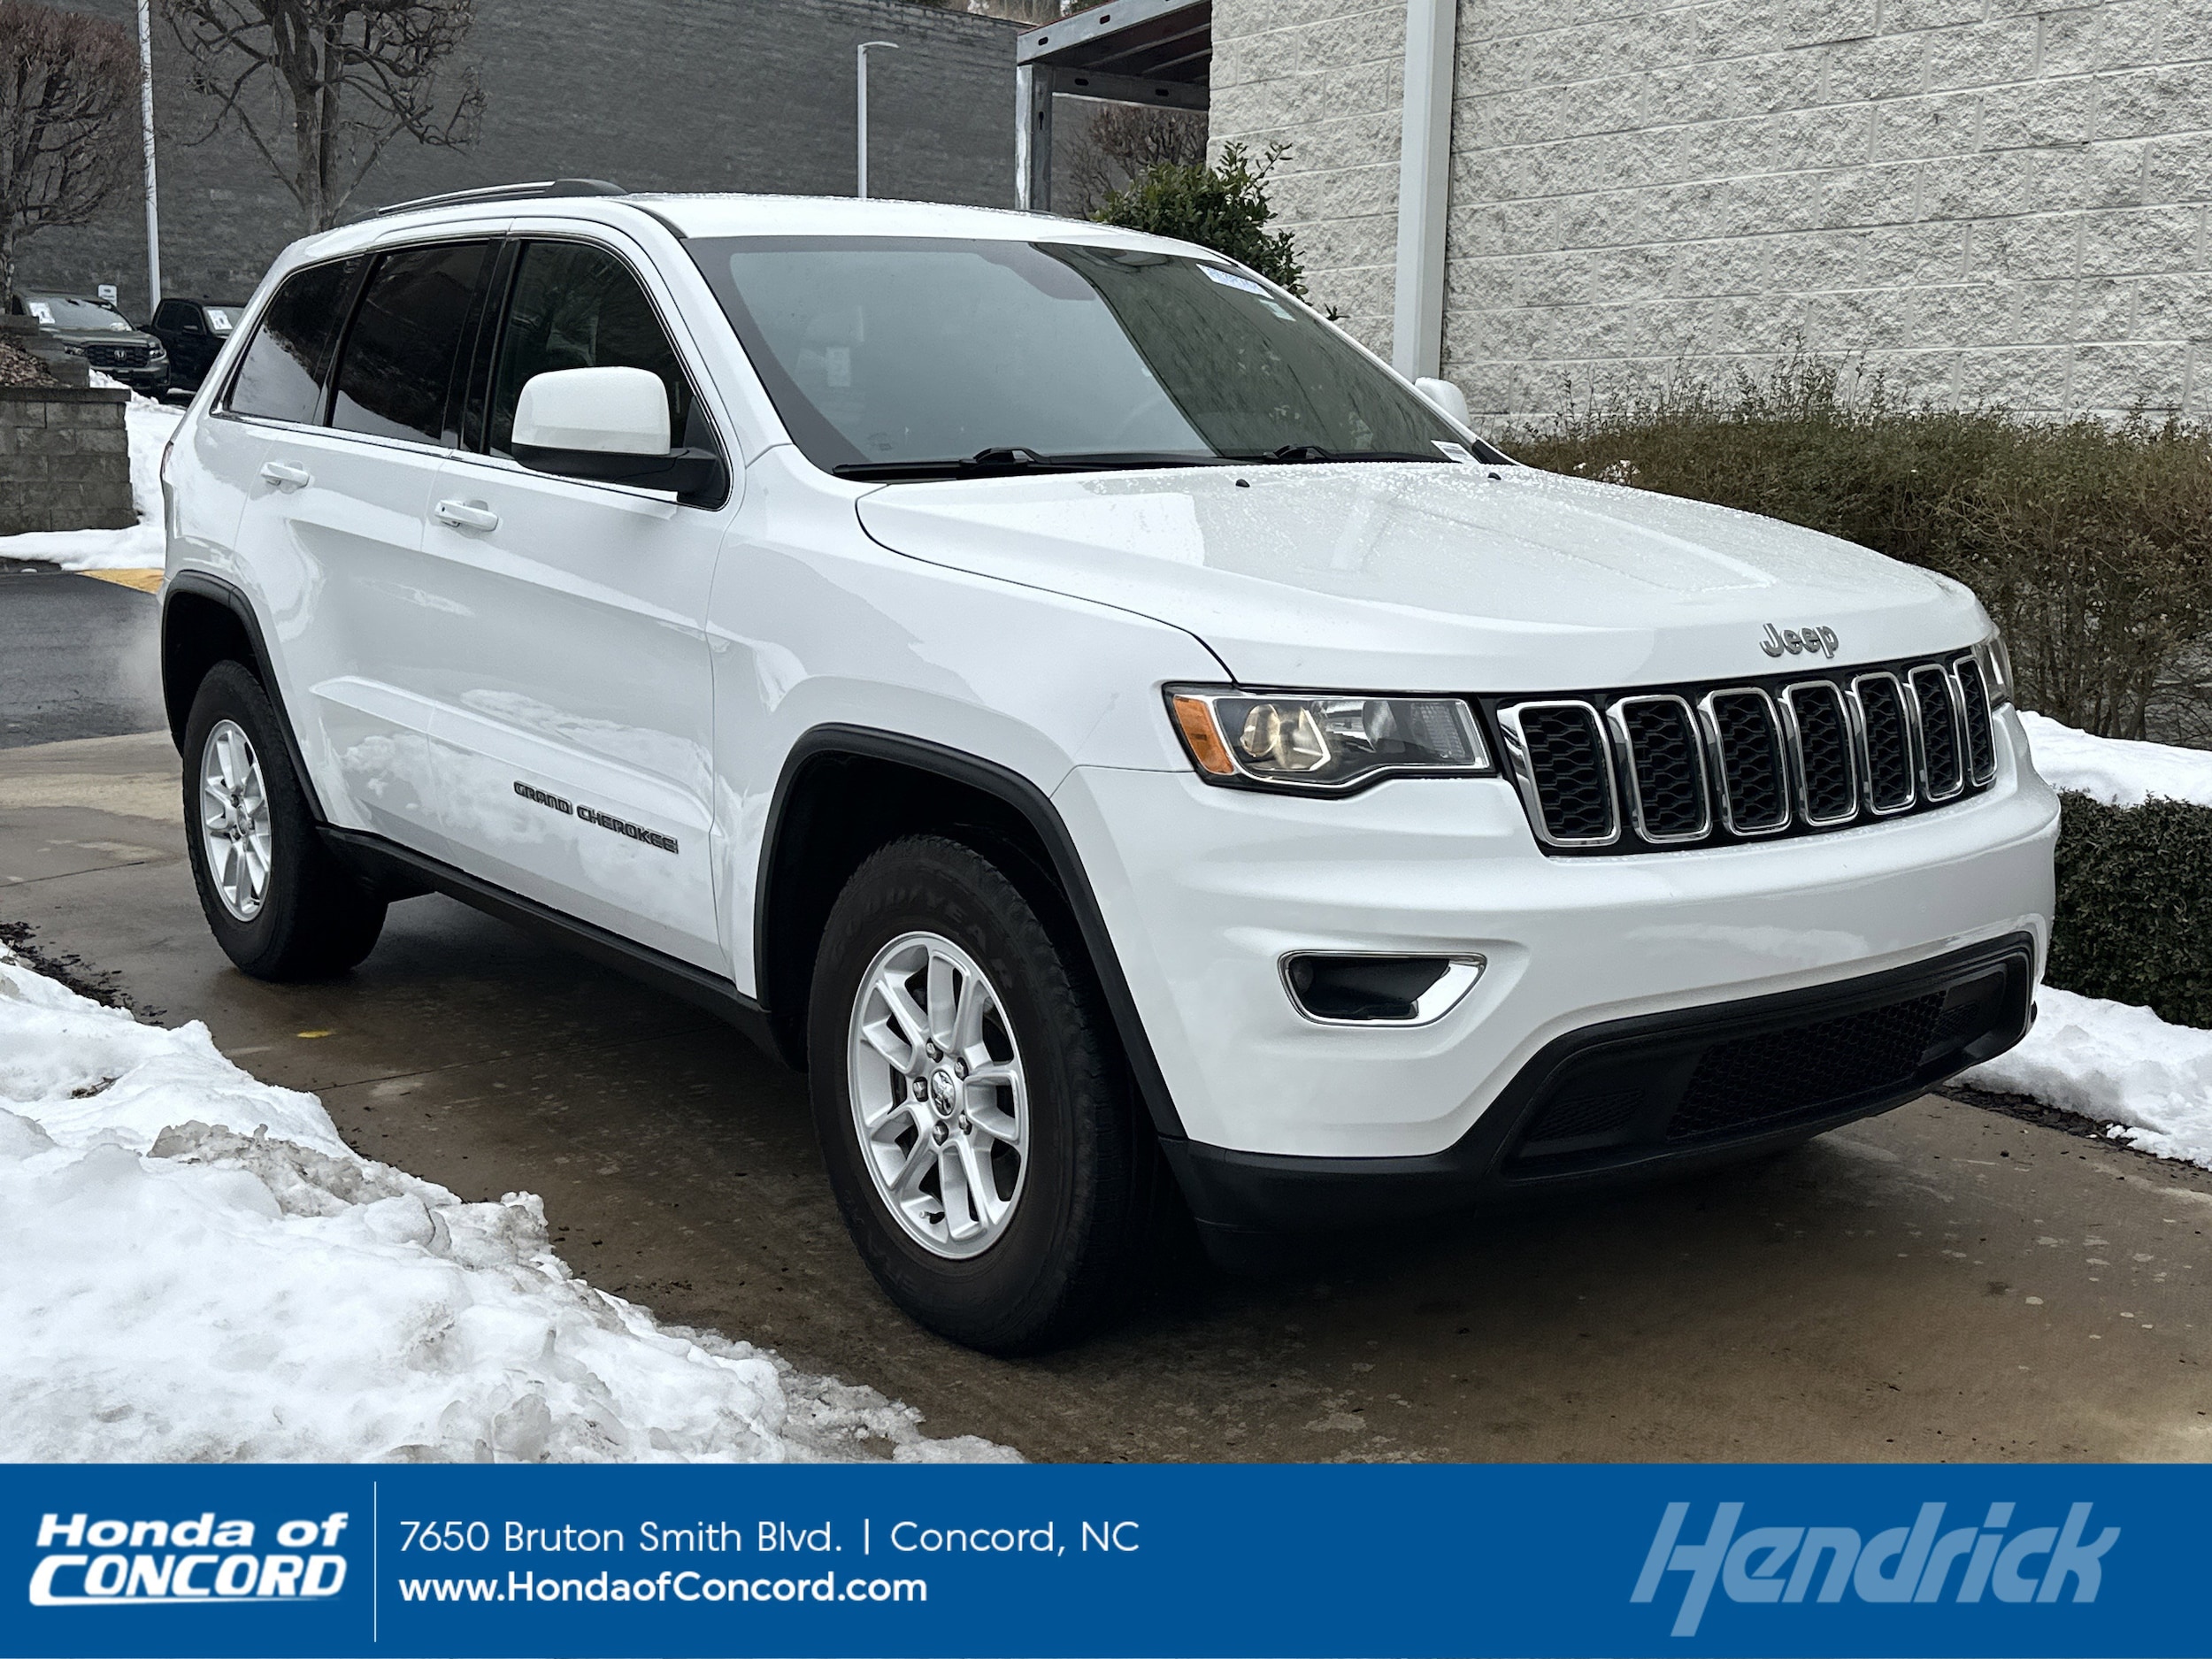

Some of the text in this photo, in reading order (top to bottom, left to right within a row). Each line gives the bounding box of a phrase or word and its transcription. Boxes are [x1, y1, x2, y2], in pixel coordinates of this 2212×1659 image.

[1759, 622, 1839, 659] Jeep
[513, 780, 680, 855] GRAND CHEROKEE
